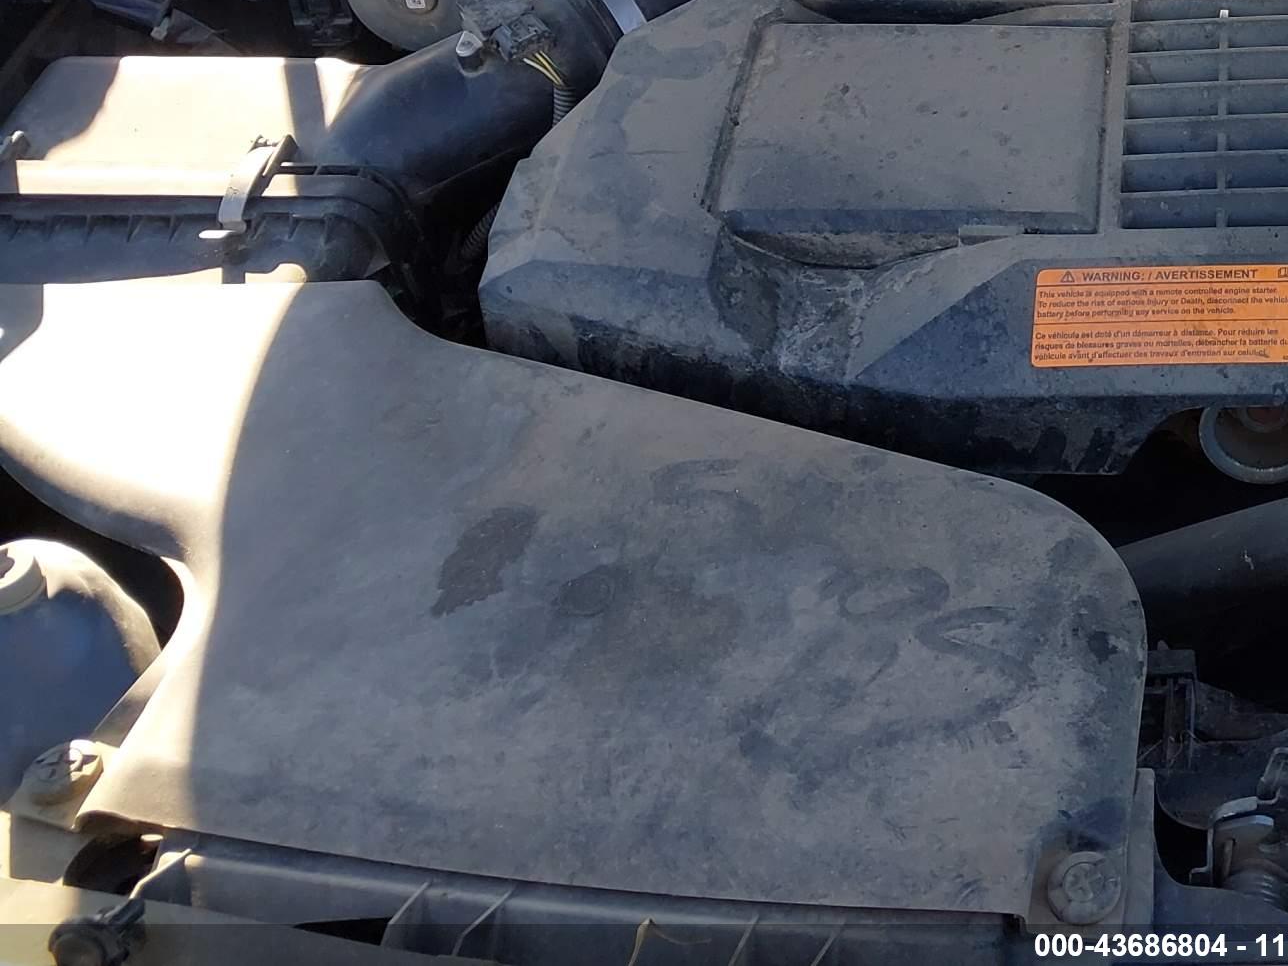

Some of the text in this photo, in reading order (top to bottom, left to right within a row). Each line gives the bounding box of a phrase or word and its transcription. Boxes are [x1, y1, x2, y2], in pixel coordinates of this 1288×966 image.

[1082, 271, 1145, 282] WARNING:
[1155, 269, 1258, 280] AVERTISSEMENT
[1094, 290, 1130, 299] equipped
[1038, 311, 1063, 319] battery
[1092, 309, 1134, 317] performing
[1048, 330, 1079, 339] véhicule
[1035, 342, 1063, 351] risques
[1116, 341, 1141, 349] graves
[1035, 352, 1066, 360] véhicule
